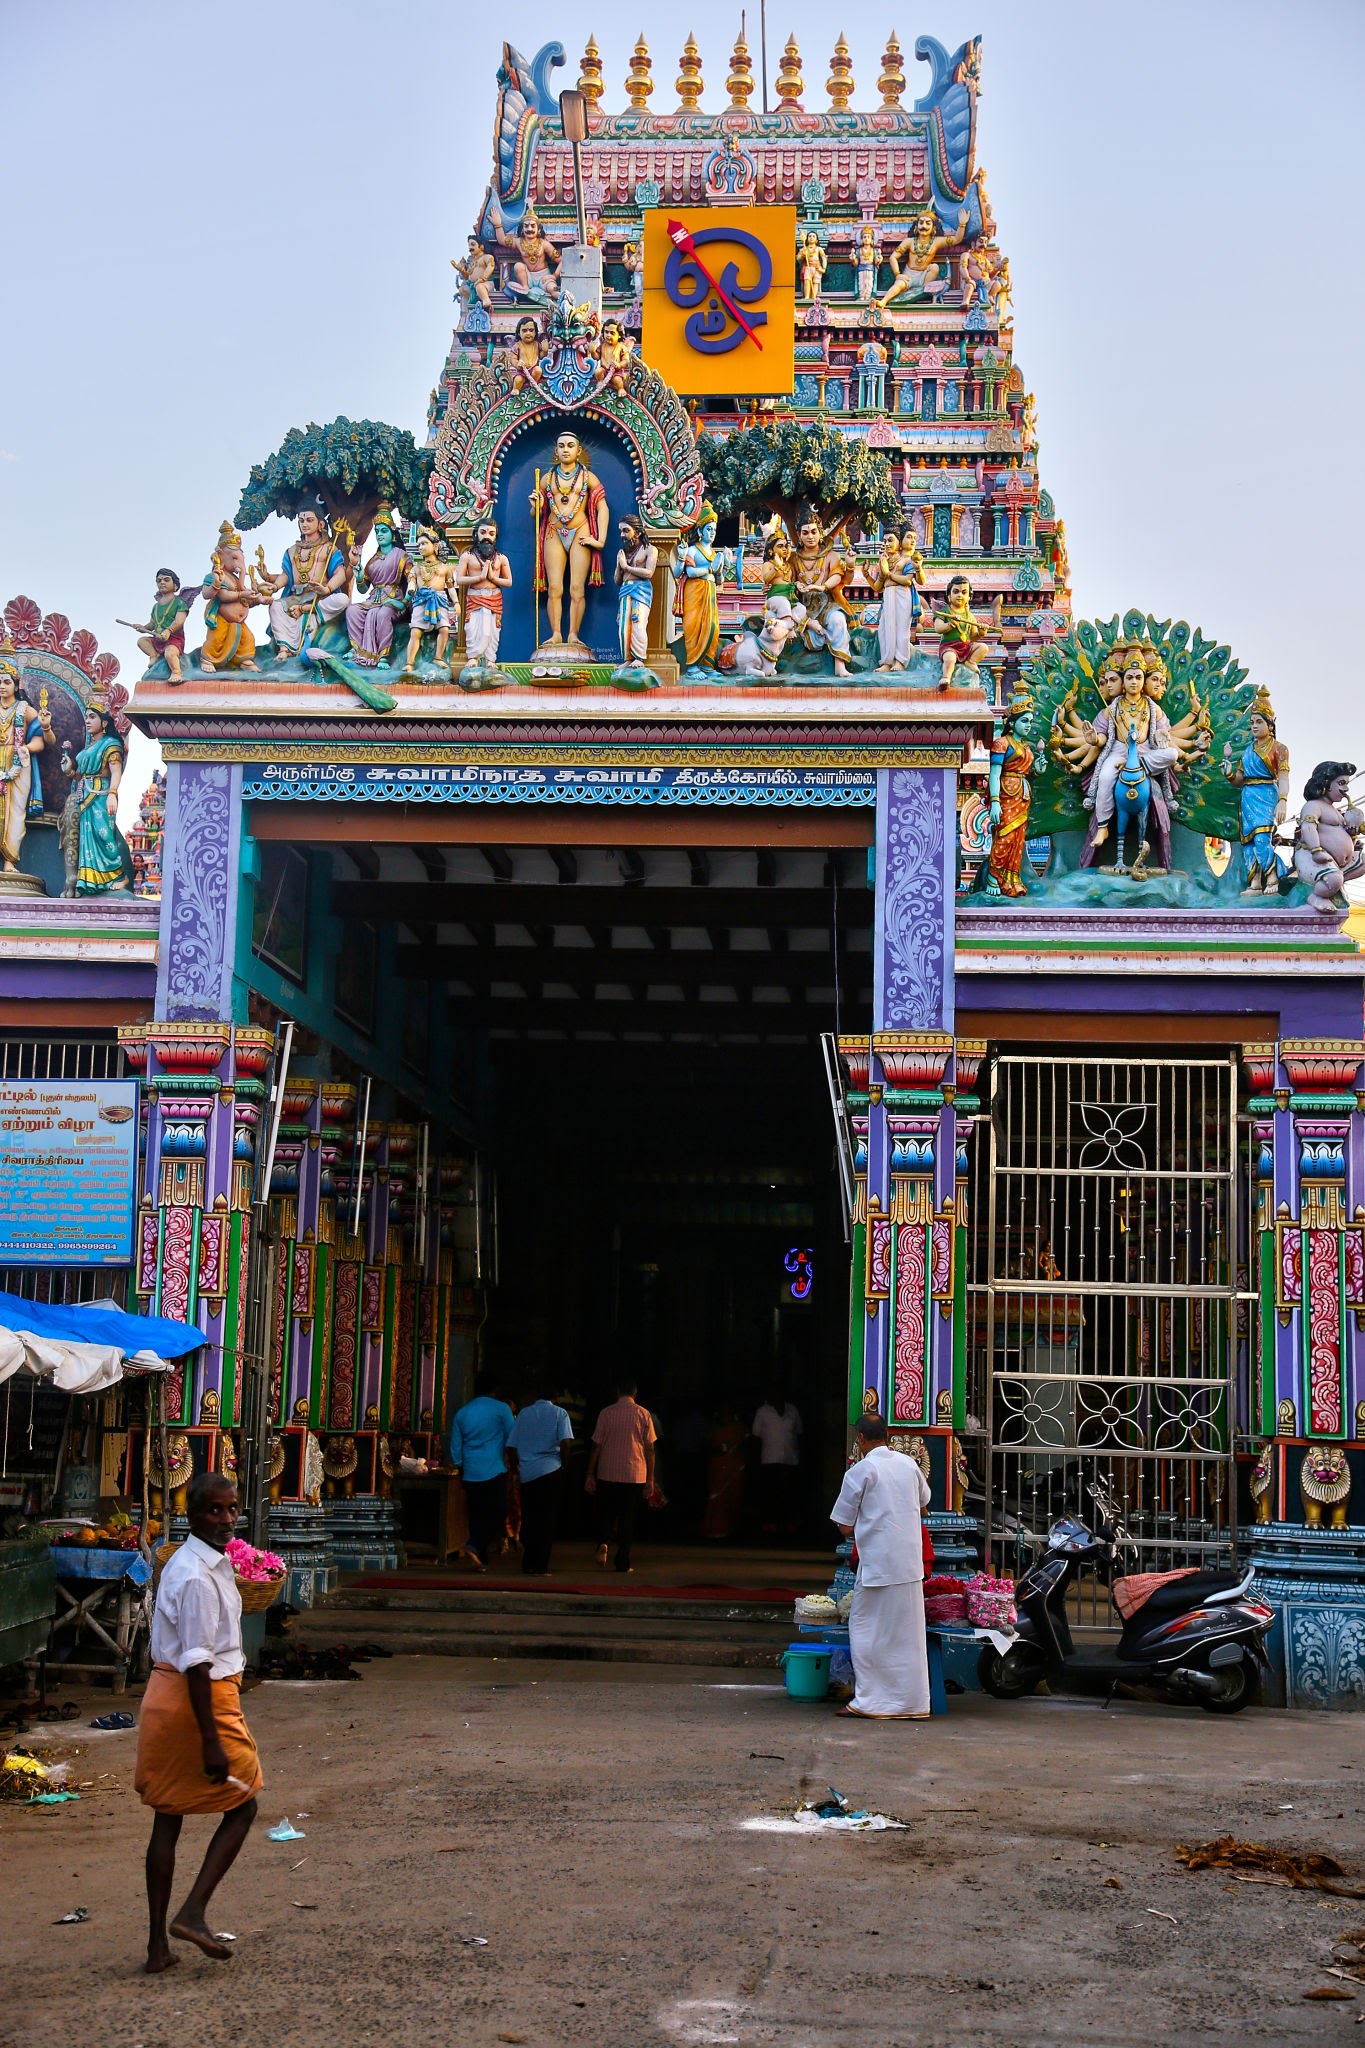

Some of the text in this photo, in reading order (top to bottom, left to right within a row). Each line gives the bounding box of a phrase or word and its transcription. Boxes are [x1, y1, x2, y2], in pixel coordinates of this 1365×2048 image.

[263, 764, 355, 782] அருள்மிகு
[366, 766, 546, 784] சுவாமிநாத
[554, 768, 664, 783] சுவாமி
[1, 1116, 95, 1132] ஏற்றும் விழா
[2, 1155, 84, 1166] சிவராத்திரியை
